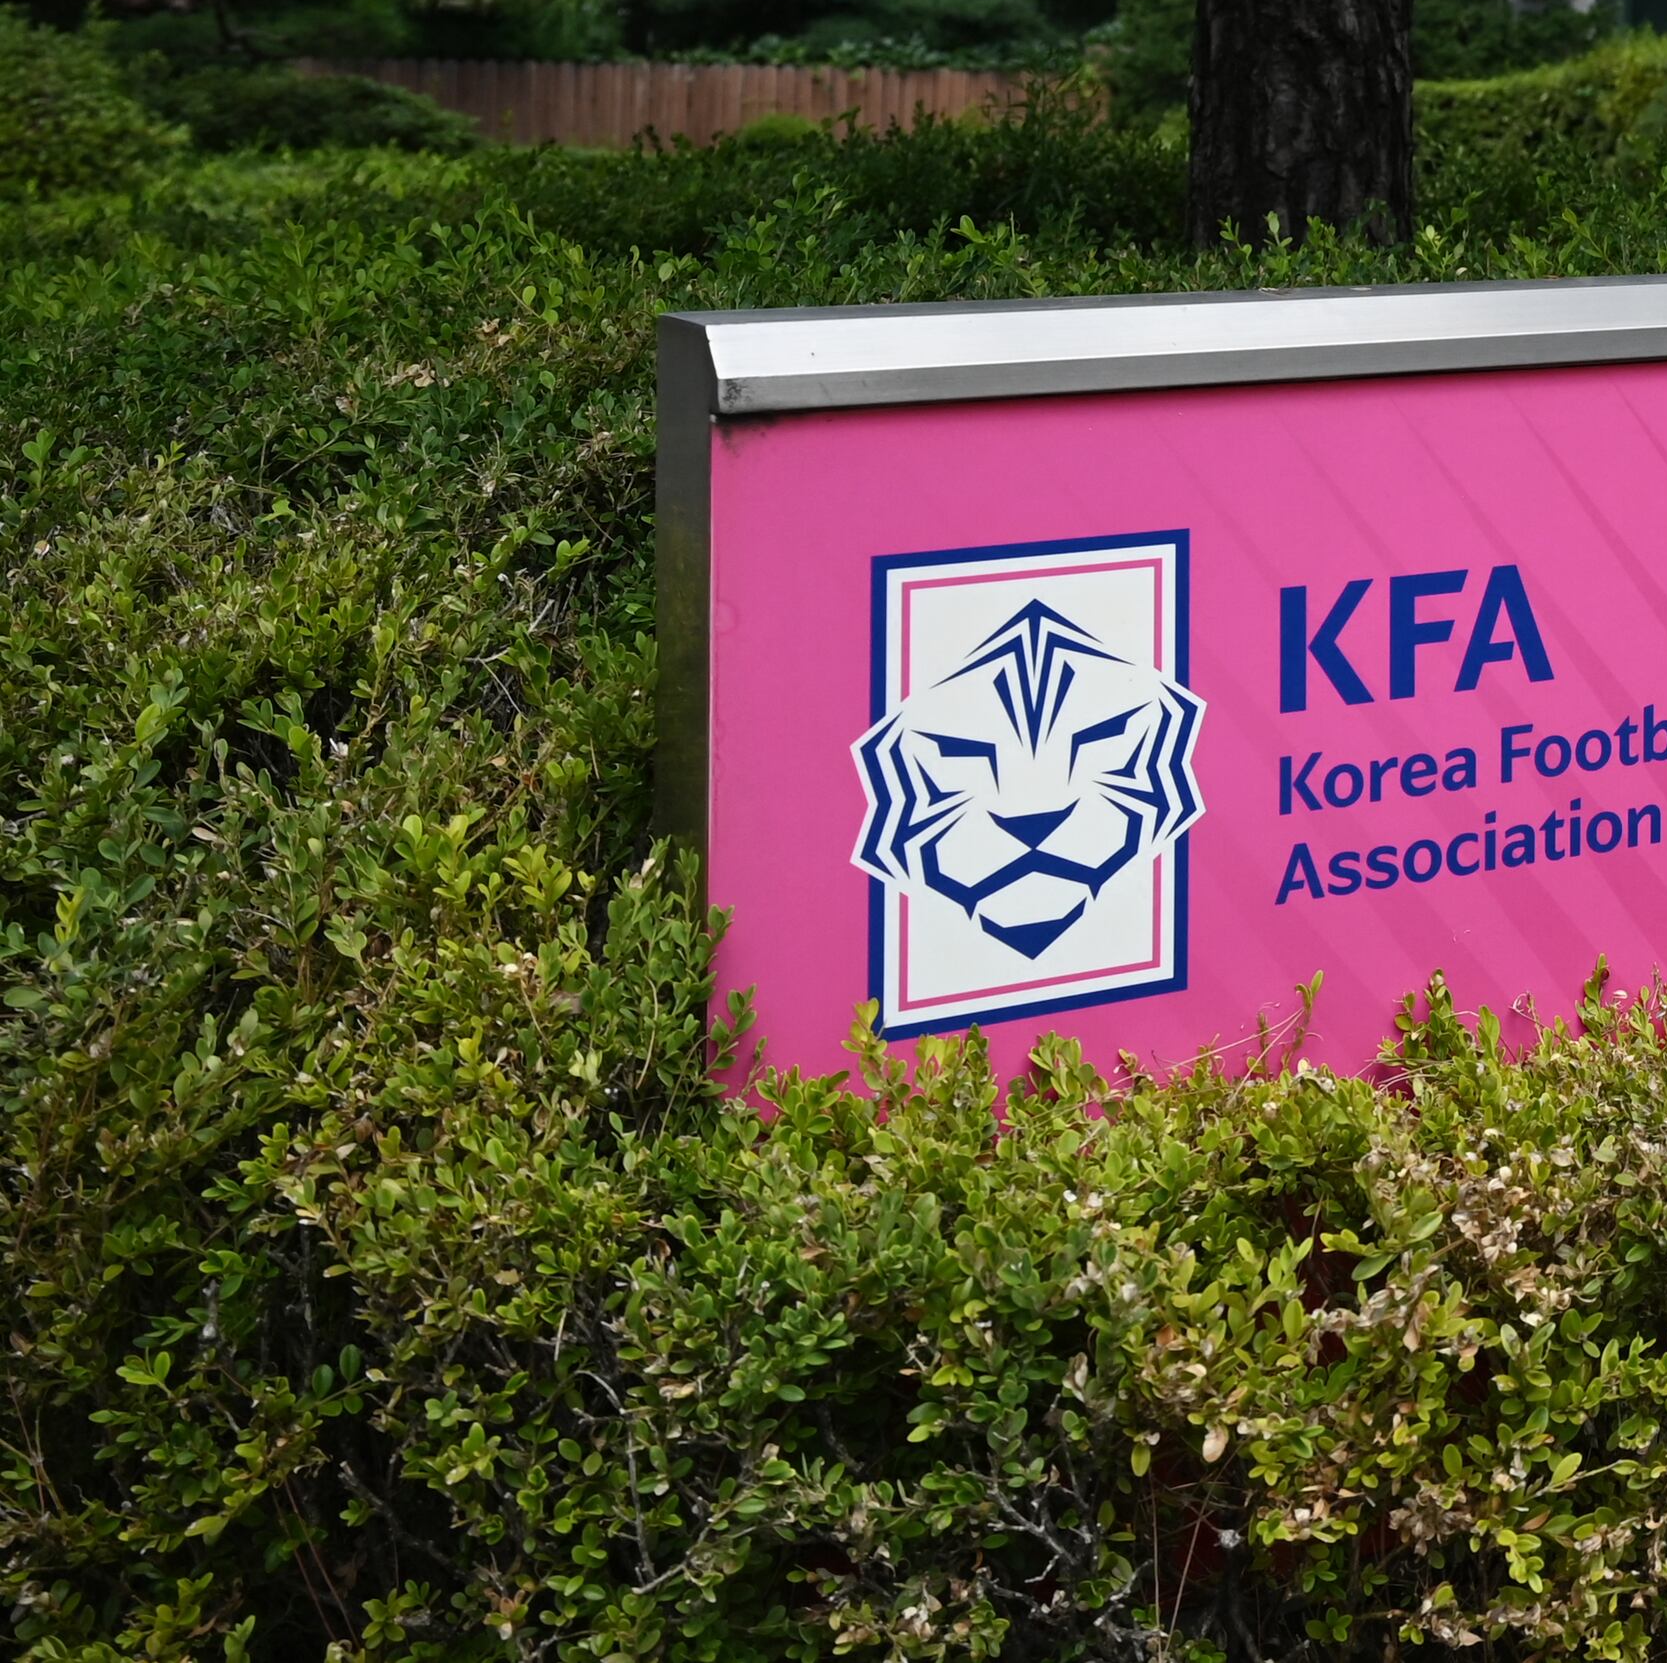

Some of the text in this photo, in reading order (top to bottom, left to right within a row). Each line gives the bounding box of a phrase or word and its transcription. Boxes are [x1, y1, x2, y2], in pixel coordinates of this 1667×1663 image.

[1279, 565, 1555, 714] KFA
[1278, 748, 1478, 816] Korea
[1275, 797, 1662, 905] Association
